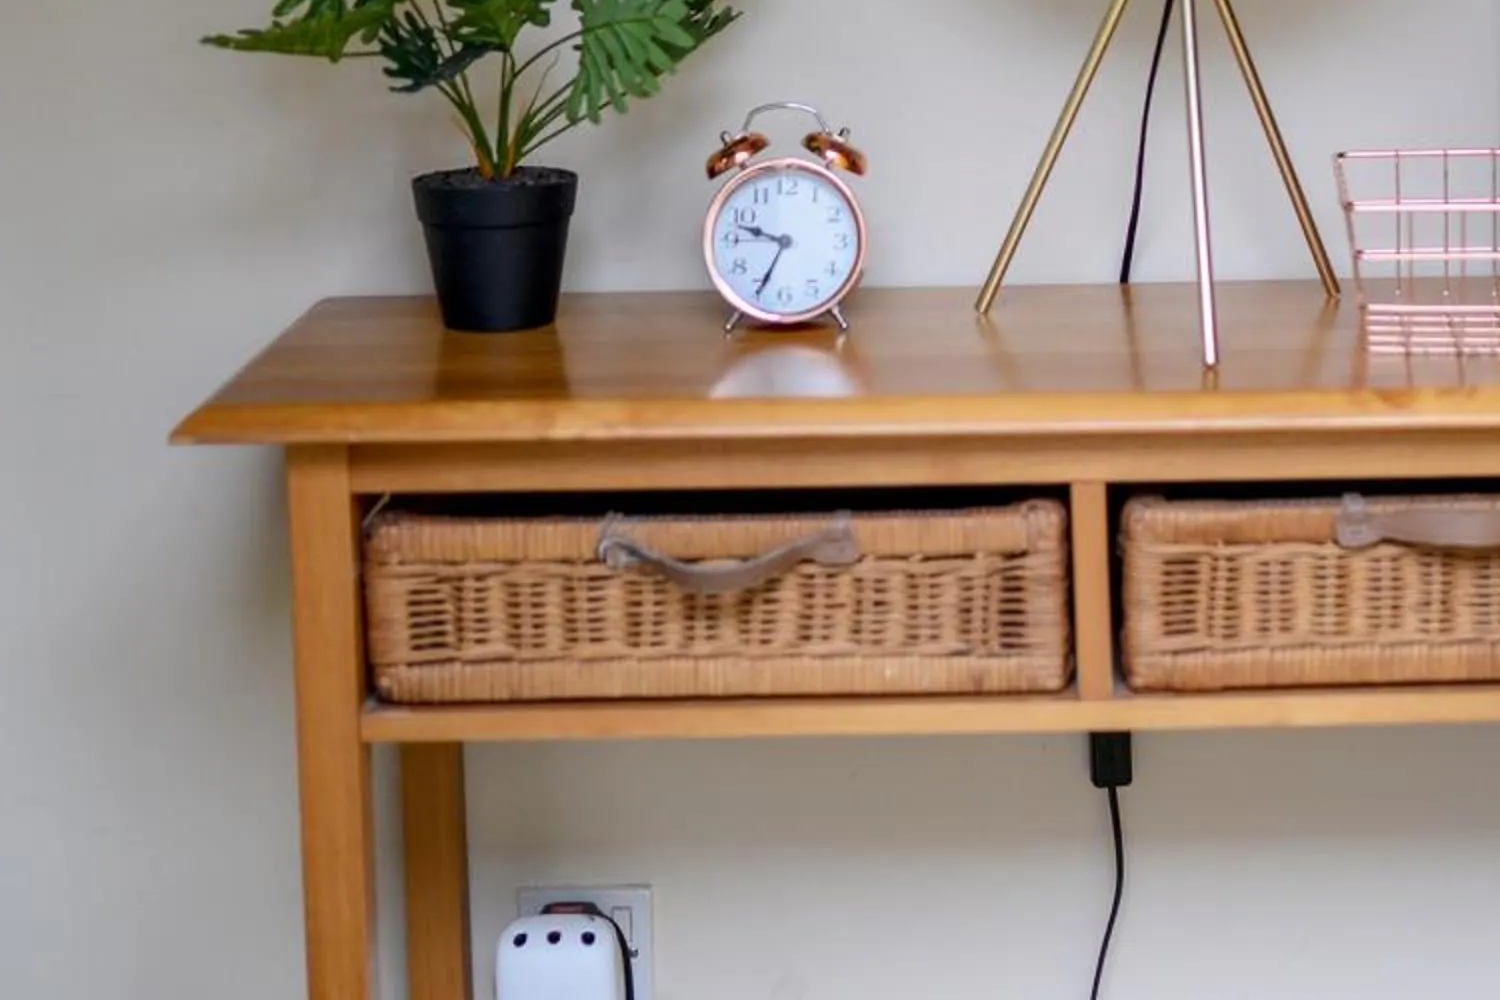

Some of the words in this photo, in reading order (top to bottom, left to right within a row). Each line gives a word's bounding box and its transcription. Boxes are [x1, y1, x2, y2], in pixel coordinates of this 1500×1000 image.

[753, 187, 769, 205] 11
[775, 178, 799, 196] 12
[734, 207, 756, 225] 10
[826, 206, 842, 222] 2
[833, 232, 849, 250] 3
[730, 258, 748, 275] 8
[824, 259, 840, 276] 4
[776, 286, 793, 304] 6
[804, 278, 820, 299] 5
